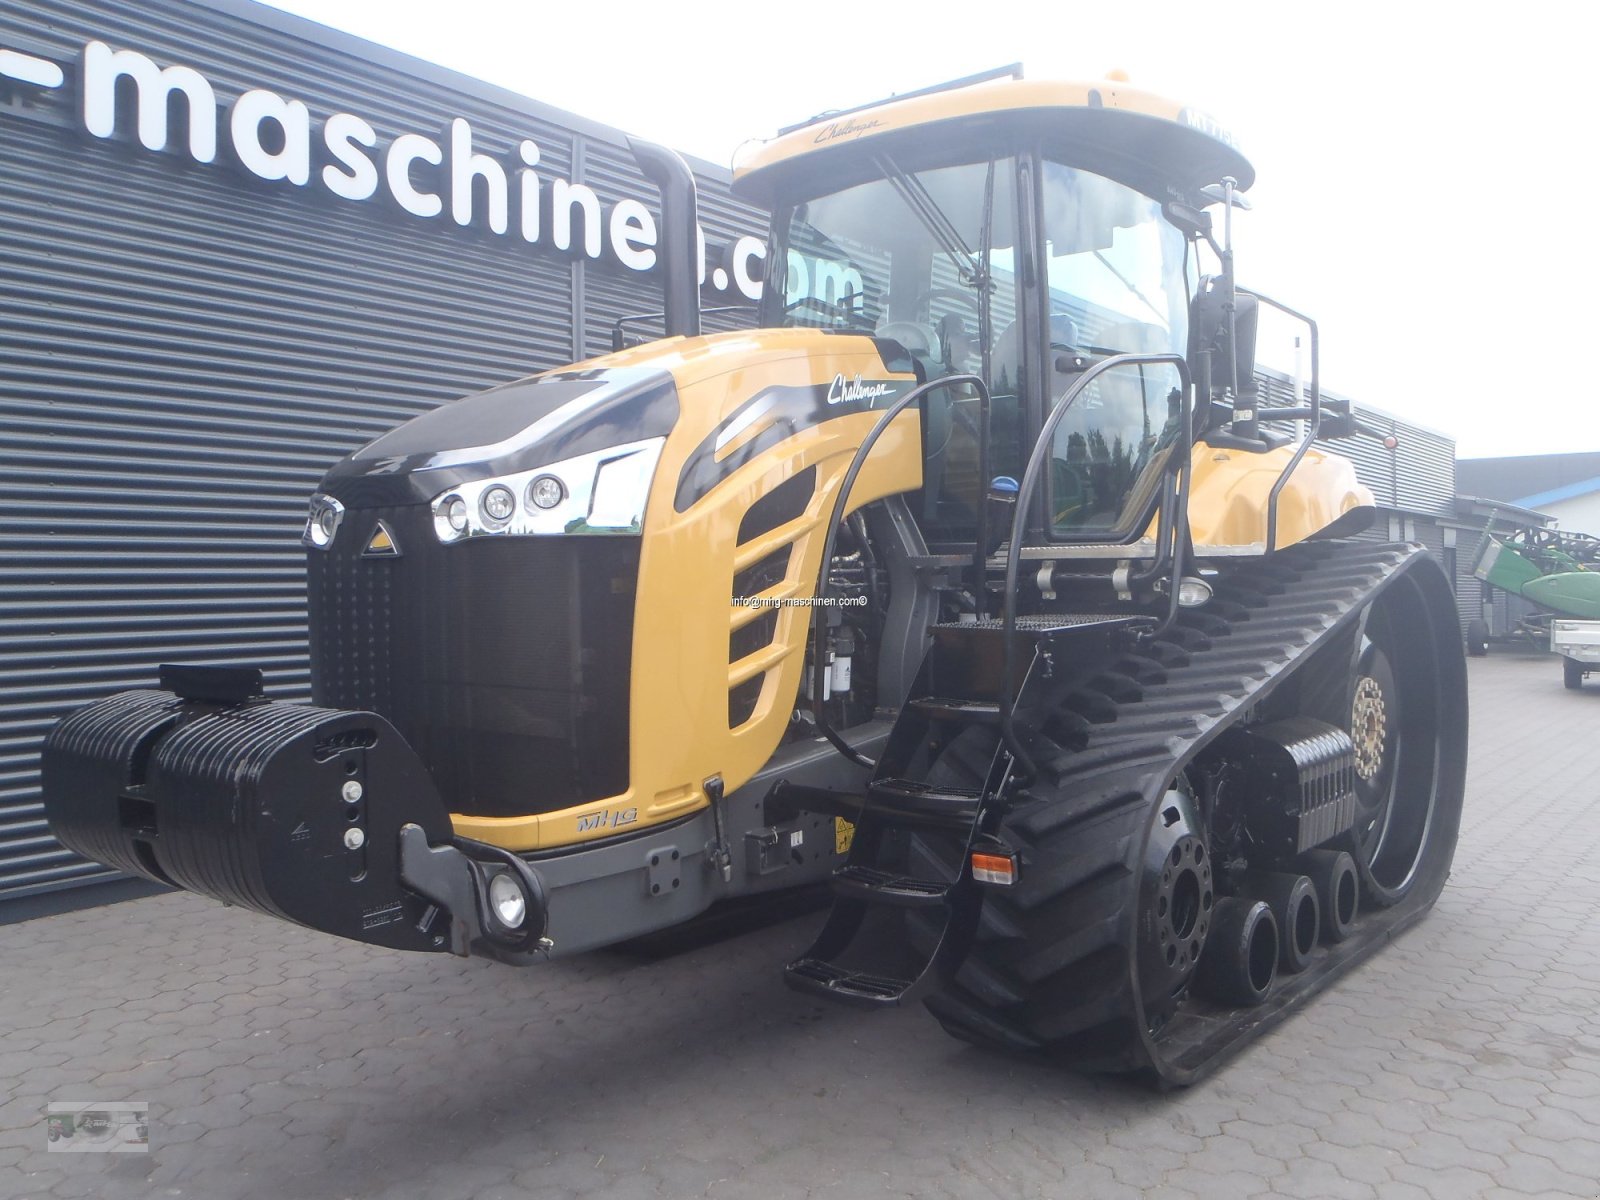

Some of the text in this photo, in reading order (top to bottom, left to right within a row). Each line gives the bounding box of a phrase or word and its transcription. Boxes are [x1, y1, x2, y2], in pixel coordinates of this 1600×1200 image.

[814, 119, 888, 143] Challenger
[827, 372, 897, 408] Challenger
[576, 807, 638, 832] MHG
